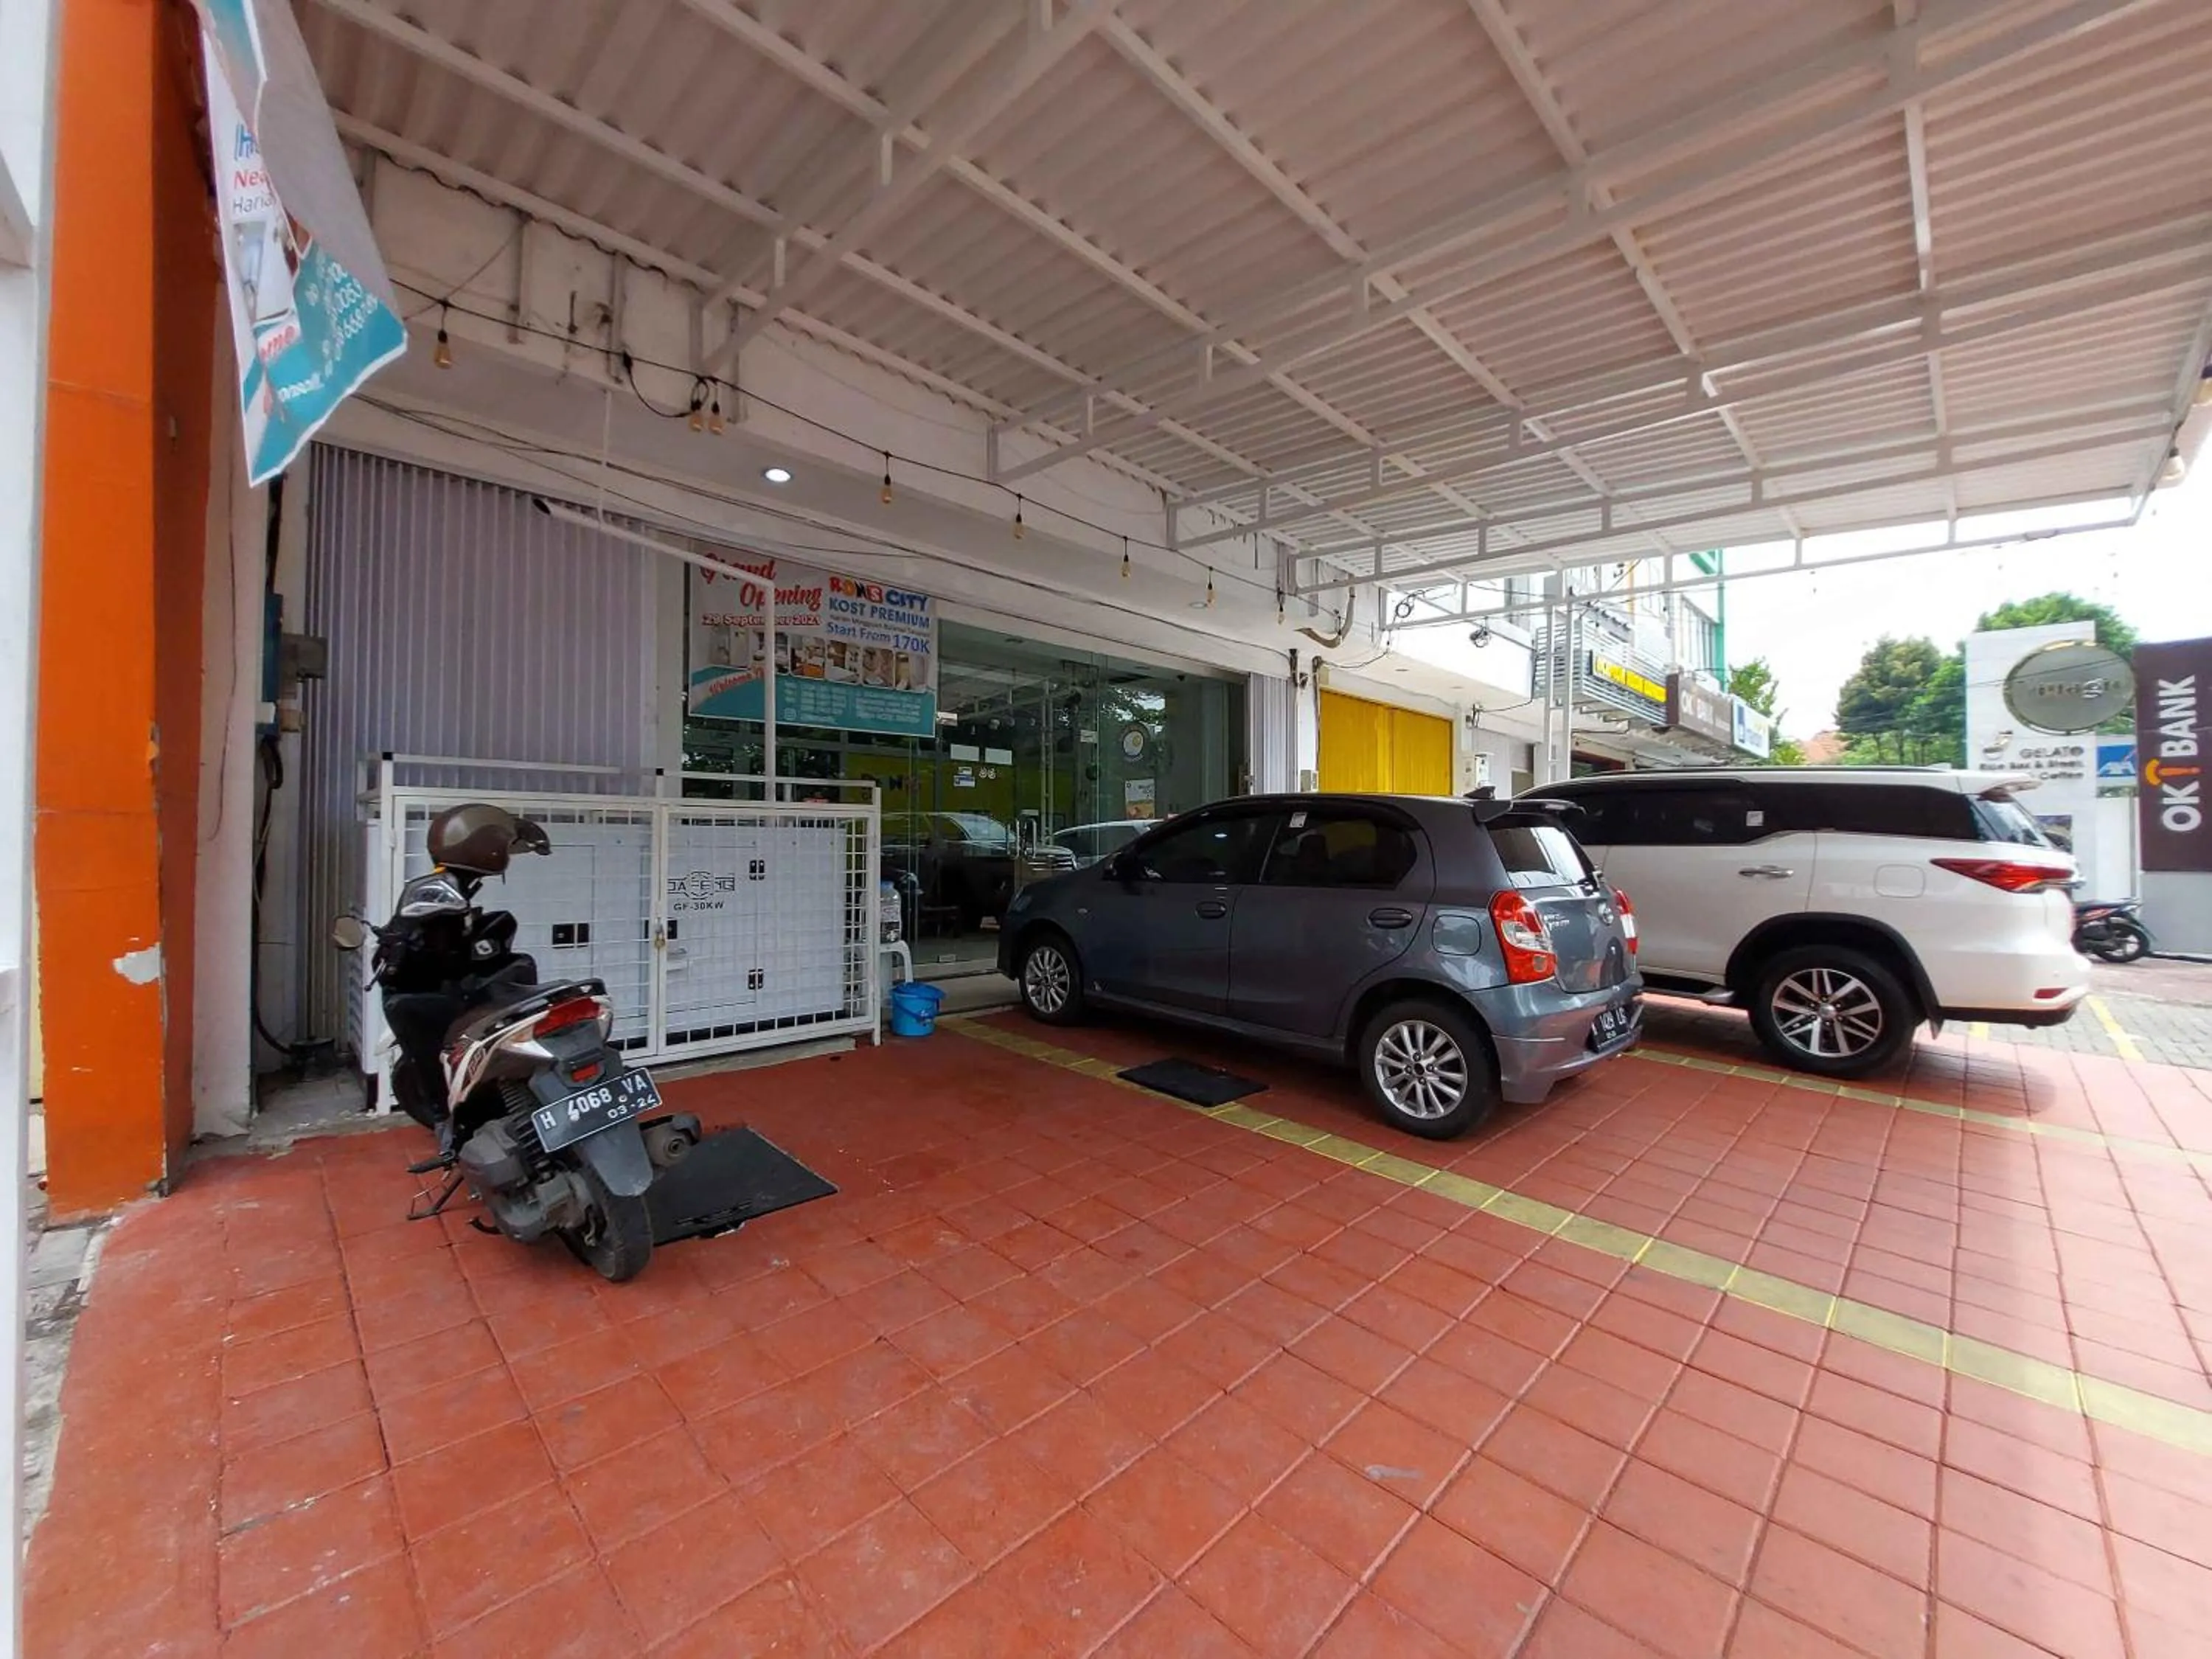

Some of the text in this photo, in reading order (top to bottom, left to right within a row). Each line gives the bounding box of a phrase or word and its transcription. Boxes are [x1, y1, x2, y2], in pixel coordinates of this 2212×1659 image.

[828, 597, 866, 616] KOST
[869, 605, 930, 629] PREMIUM
[886, 588, 929, 612] CITY
[827, 621, 858, 638] Start
[859, 627, 891, 643] From
[893, 634, 931, 655] 170K
[2157, 674, 2199, 758] BANK
[2020, 746, 2084, 759] GELATO
[540, 1074, 647, 1130] H 4068 VA
